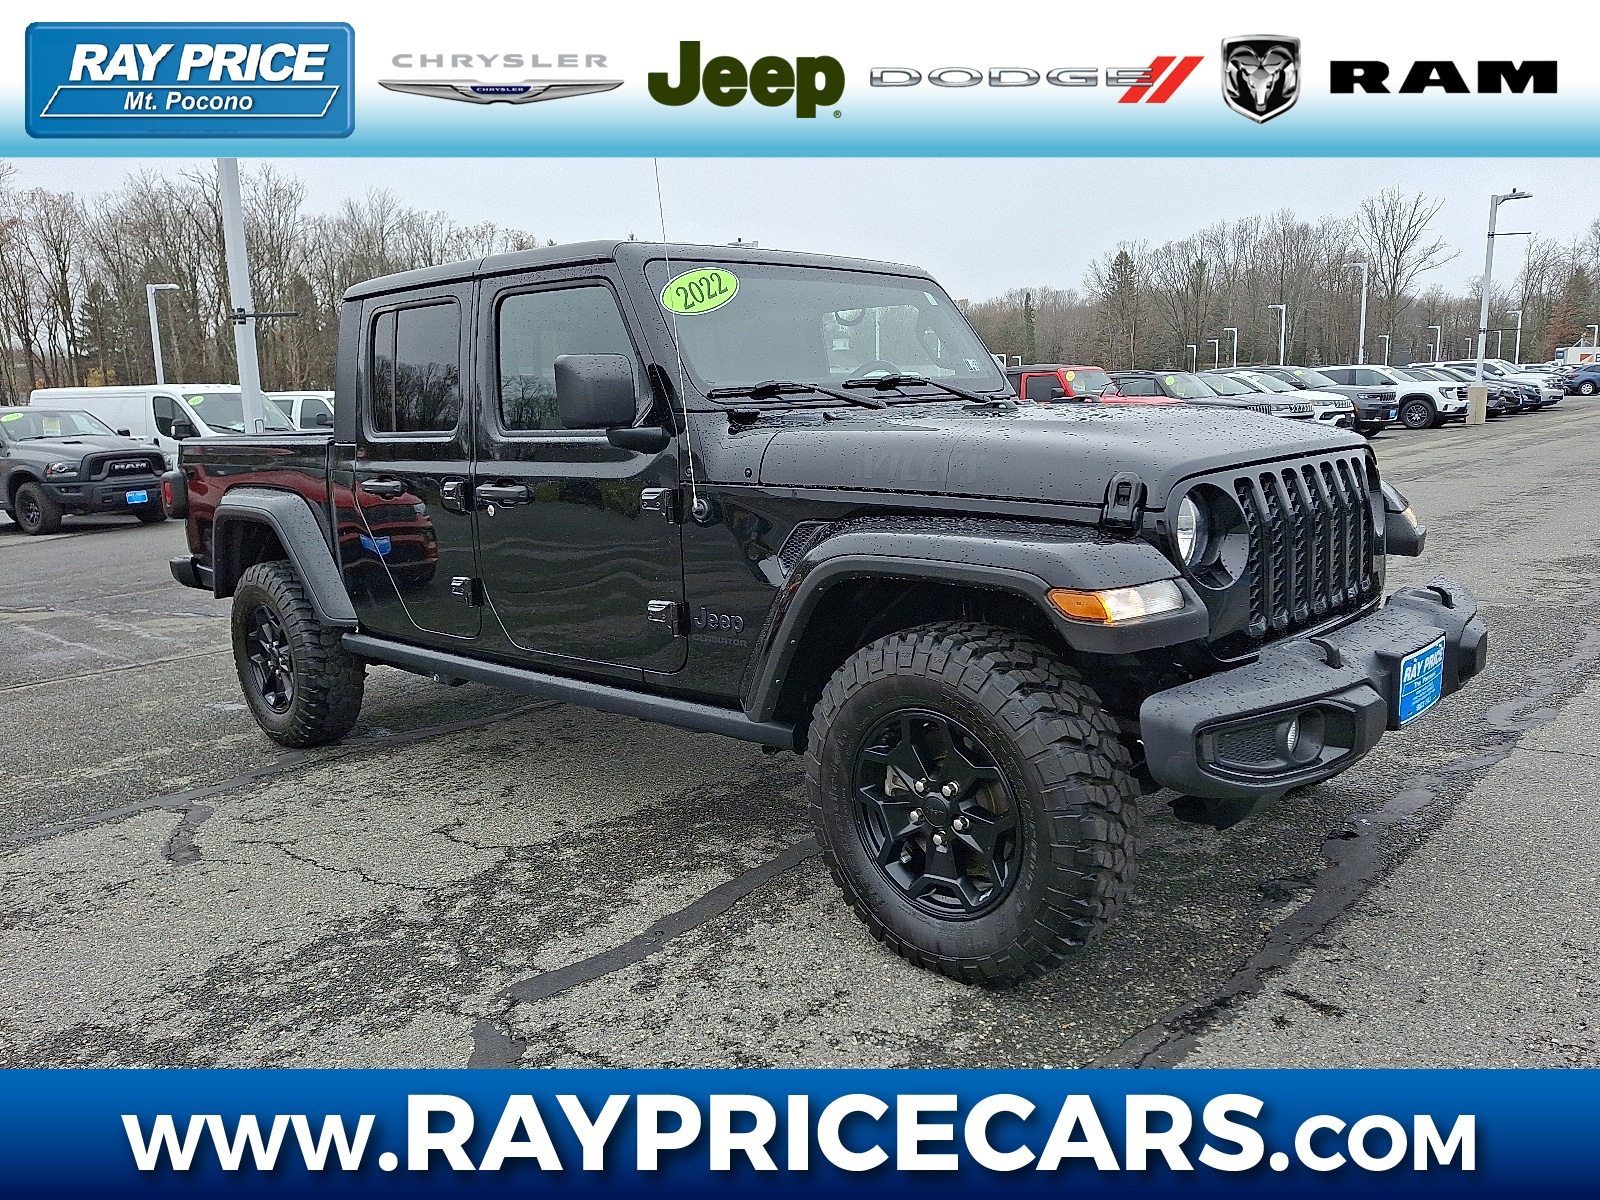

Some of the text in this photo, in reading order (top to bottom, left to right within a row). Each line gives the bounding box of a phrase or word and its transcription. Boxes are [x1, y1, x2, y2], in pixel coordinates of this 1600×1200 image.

[675, 272, 728, 310] 2022
[693, 607, 744, 635] Jeep
[1403, 645, 1444, 683] RAY PRICE
